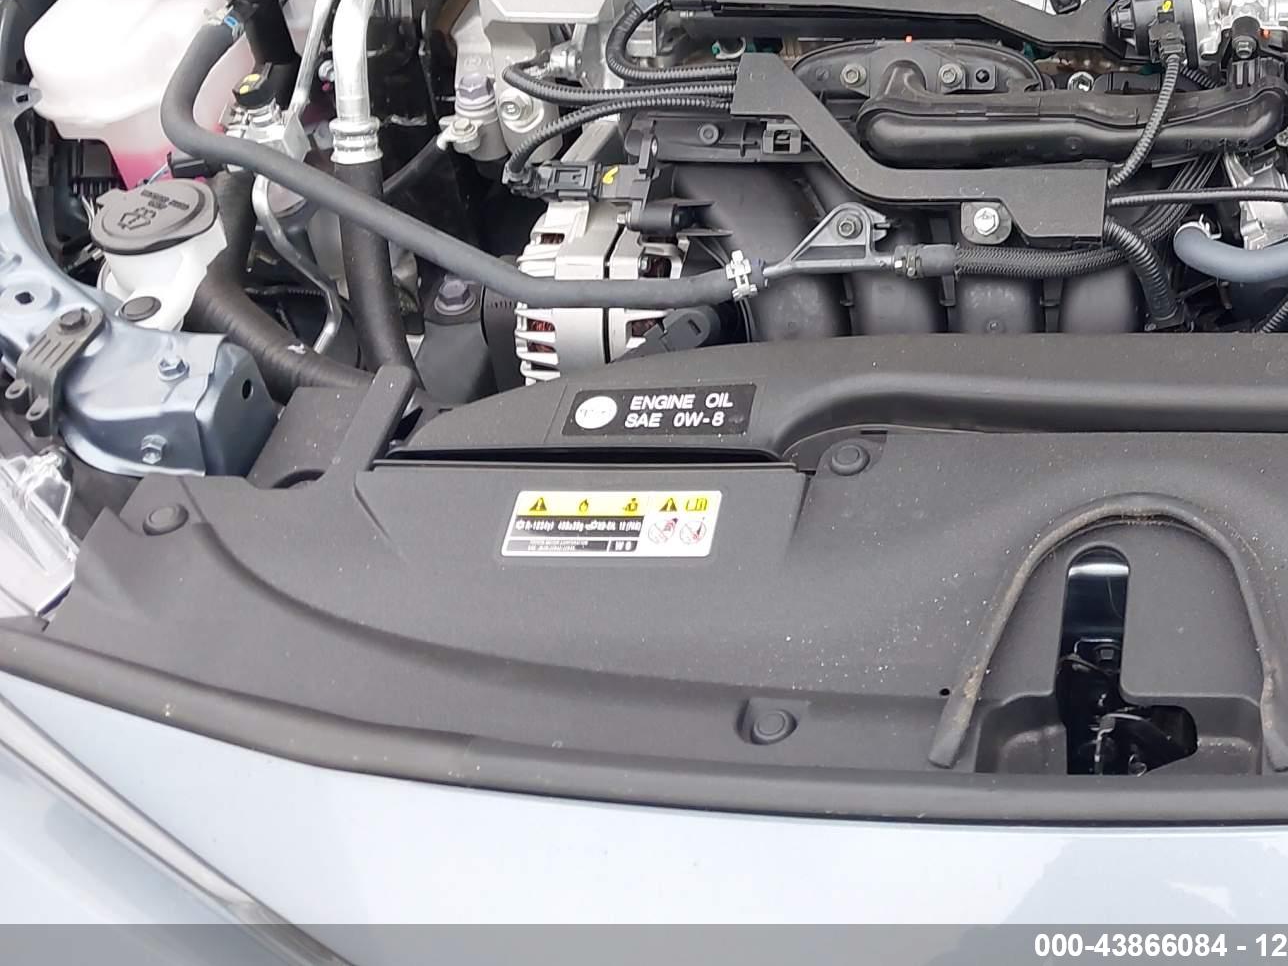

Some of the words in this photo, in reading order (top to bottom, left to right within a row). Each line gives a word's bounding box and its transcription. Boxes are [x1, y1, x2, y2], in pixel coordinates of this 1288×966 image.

[630, 394, 696, 410] ENGINE
[705, 392, 734, 409] OIL
[624, 411, 662, 428] SAE
[673, 411, 725, 428] 0W-8
